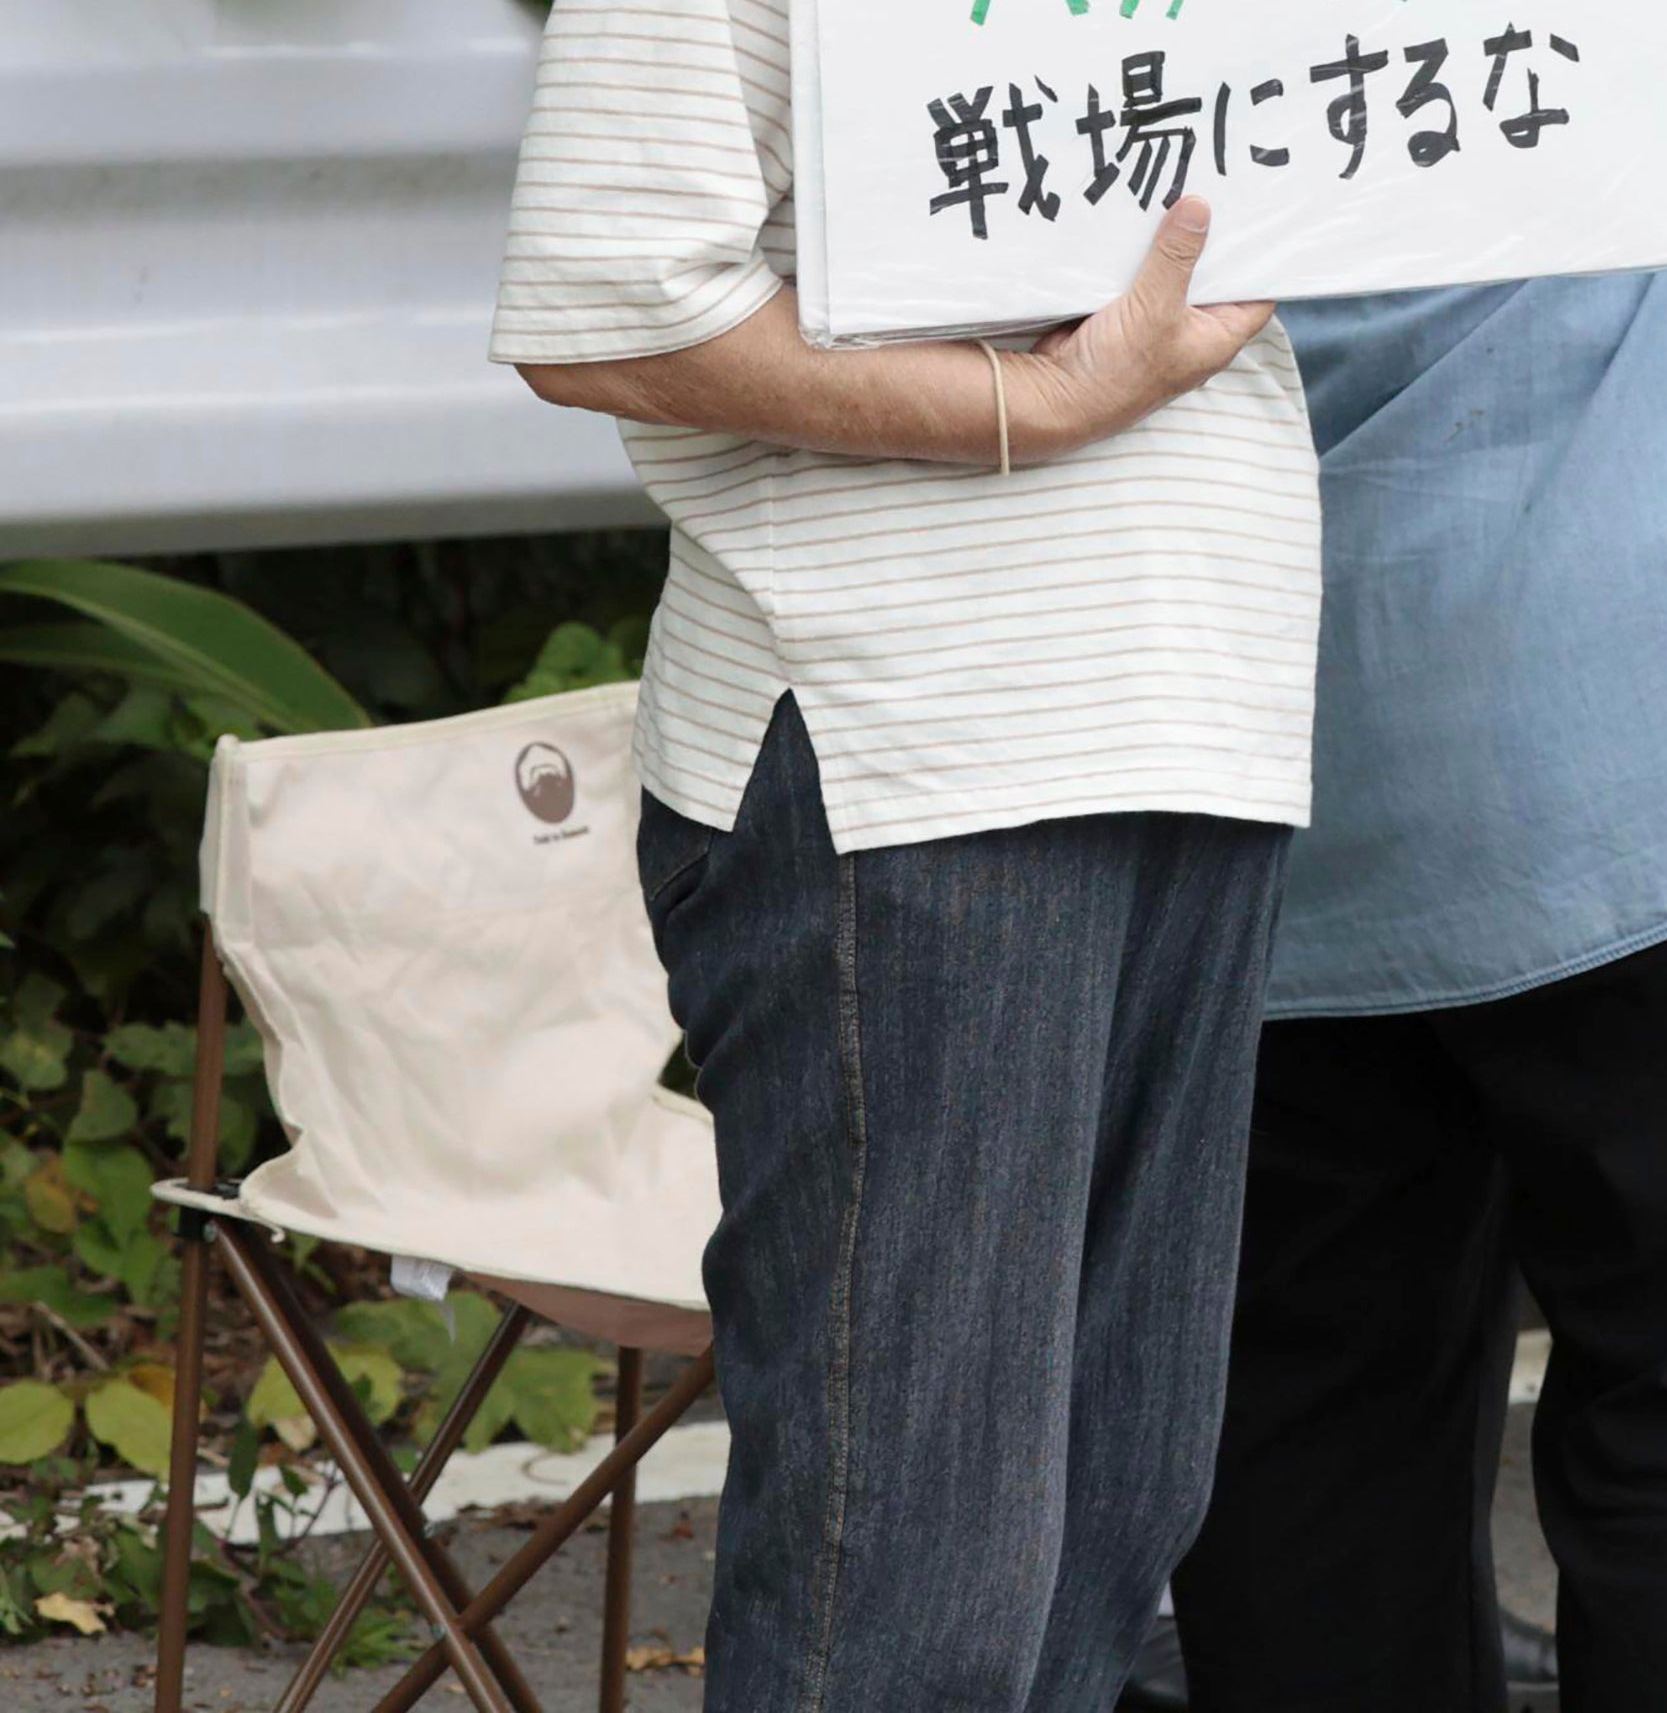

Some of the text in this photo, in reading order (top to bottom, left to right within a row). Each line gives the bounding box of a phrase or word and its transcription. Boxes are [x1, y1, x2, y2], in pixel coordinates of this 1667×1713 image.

[926, 22, 1580, 239] 戦場にするな
